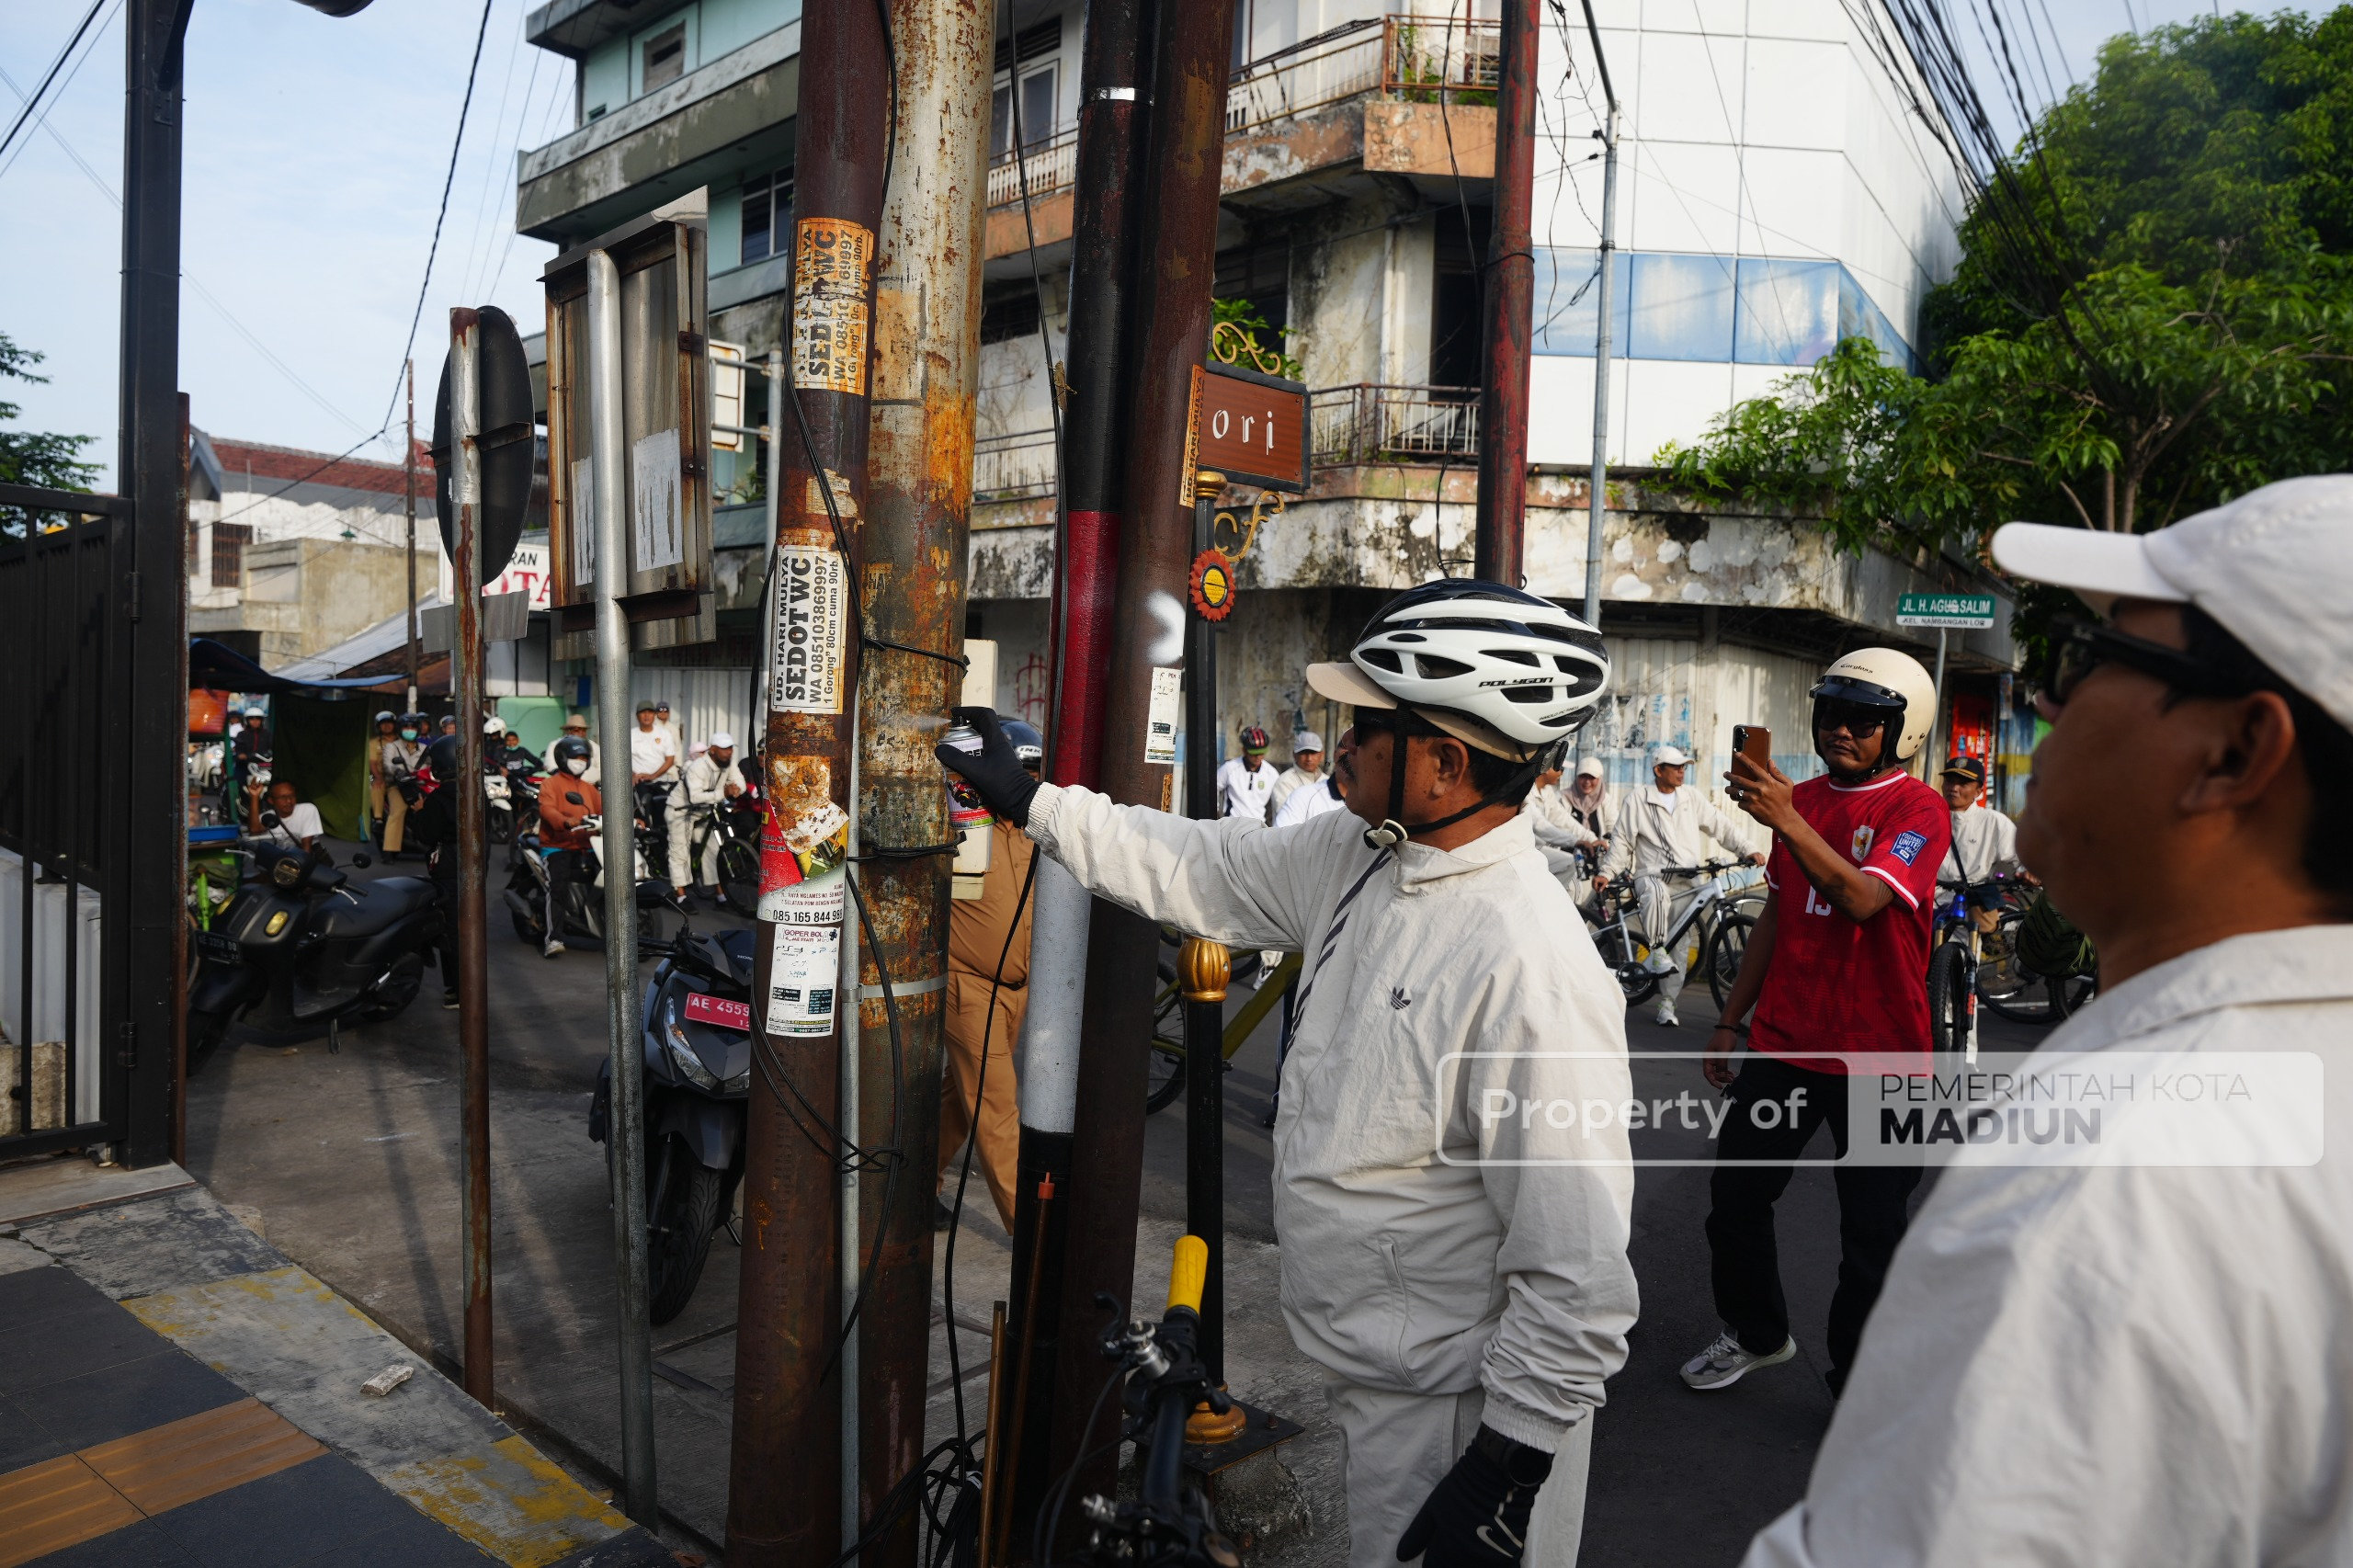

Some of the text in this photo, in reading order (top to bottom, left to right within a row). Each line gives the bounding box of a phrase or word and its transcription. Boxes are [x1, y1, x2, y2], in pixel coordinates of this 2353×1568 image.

[813, 231, 836, 277] WC
[829, 588, 837, 617] cuma
[1903, 598, 1991, 614] JL. H. AGUS SALIM
[776, 556, 789, 701] UD. HARI MULYA
[785, 558, 811, 700] SEDOT WC
[809, 556, 827, 703] WA 085103869997
[826, 620, 836, 648] 80cm
[1478, 676, 1554, 687] POLYGON
[773, 909, 790, 922] 085
[793, 911, 810, 923] 165
[813, 911, 830, 922] 844
[691, 997, 749, 1017] AE 4559
